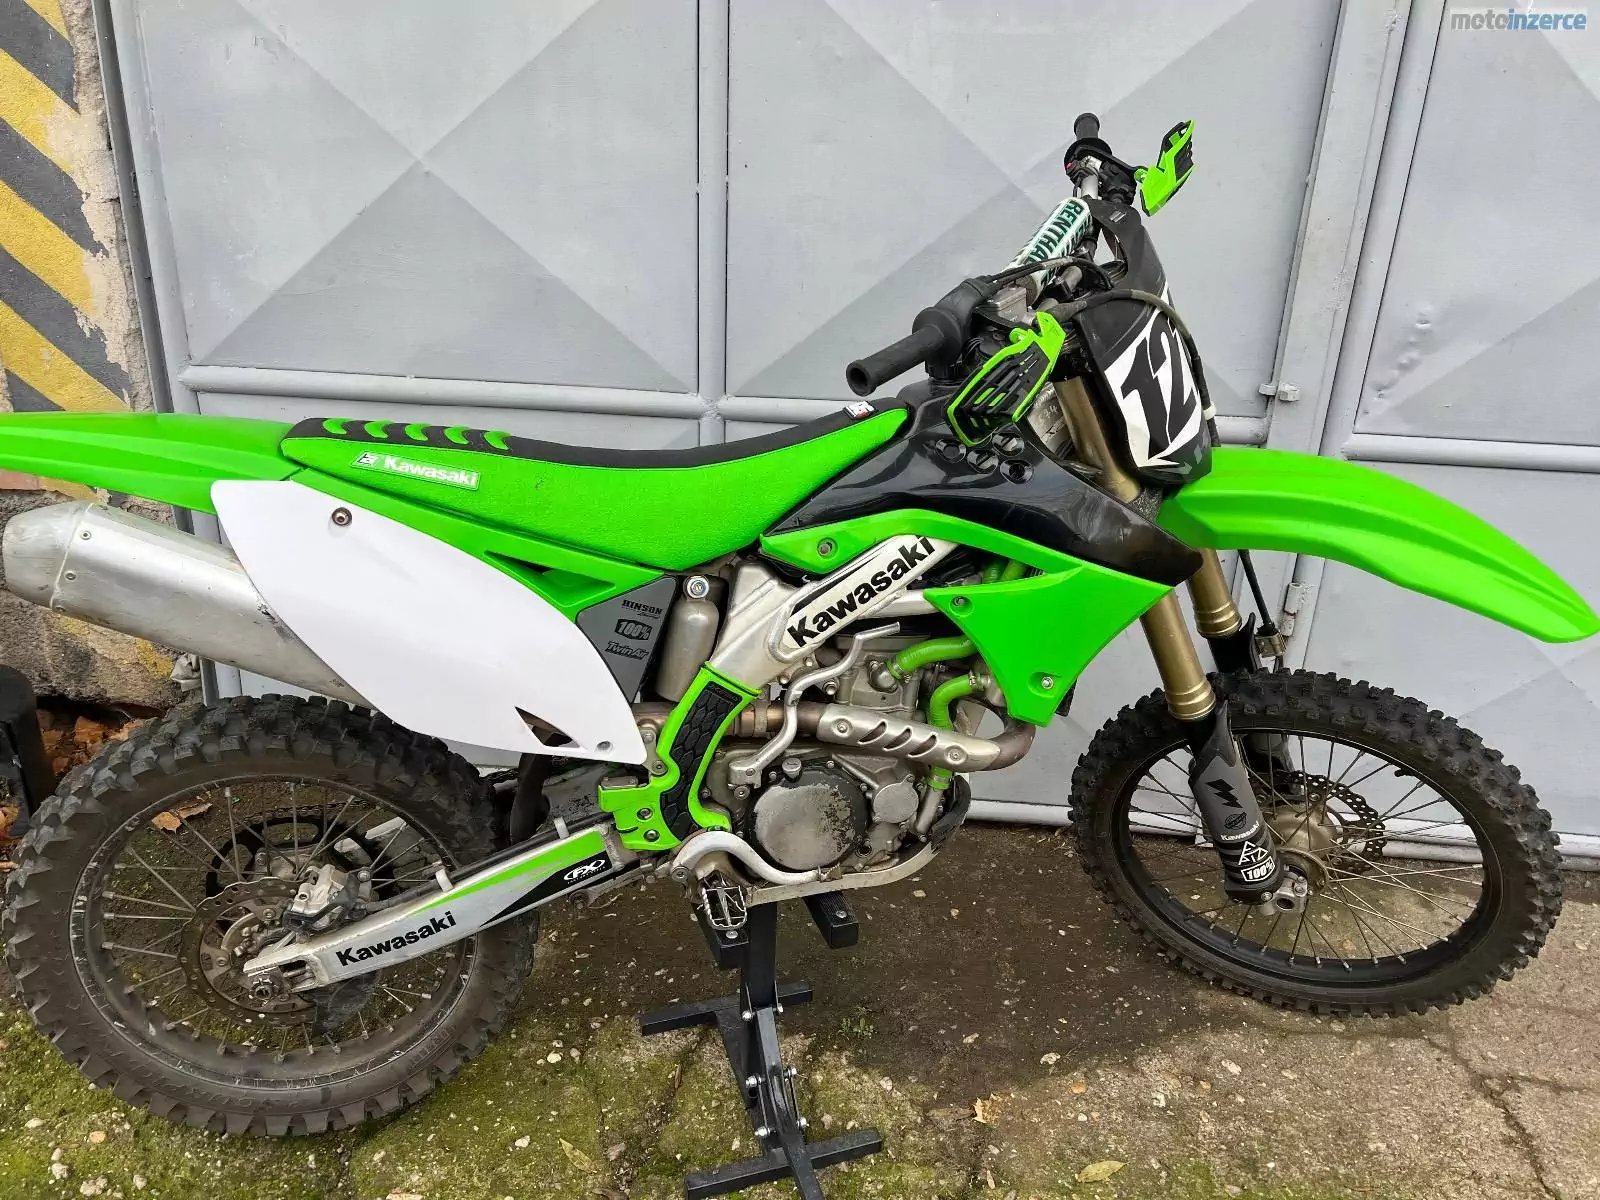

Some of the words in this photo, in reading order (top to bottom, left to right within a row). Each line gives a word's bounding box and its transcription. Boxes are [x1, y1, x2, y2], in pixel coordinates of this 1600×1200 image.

[384, 455, 478, 487] Kawasaki
[787, 535, 935, 648] Kawasaki
[622, 599, 663, 615] HINSON
[616, 620, 651, 640] 100%
[1220, 820, 1260, 841] Kawasaki
[1246, 860, 1274, 880] 100%
[335, 910, 457, 967] Kawasaki
